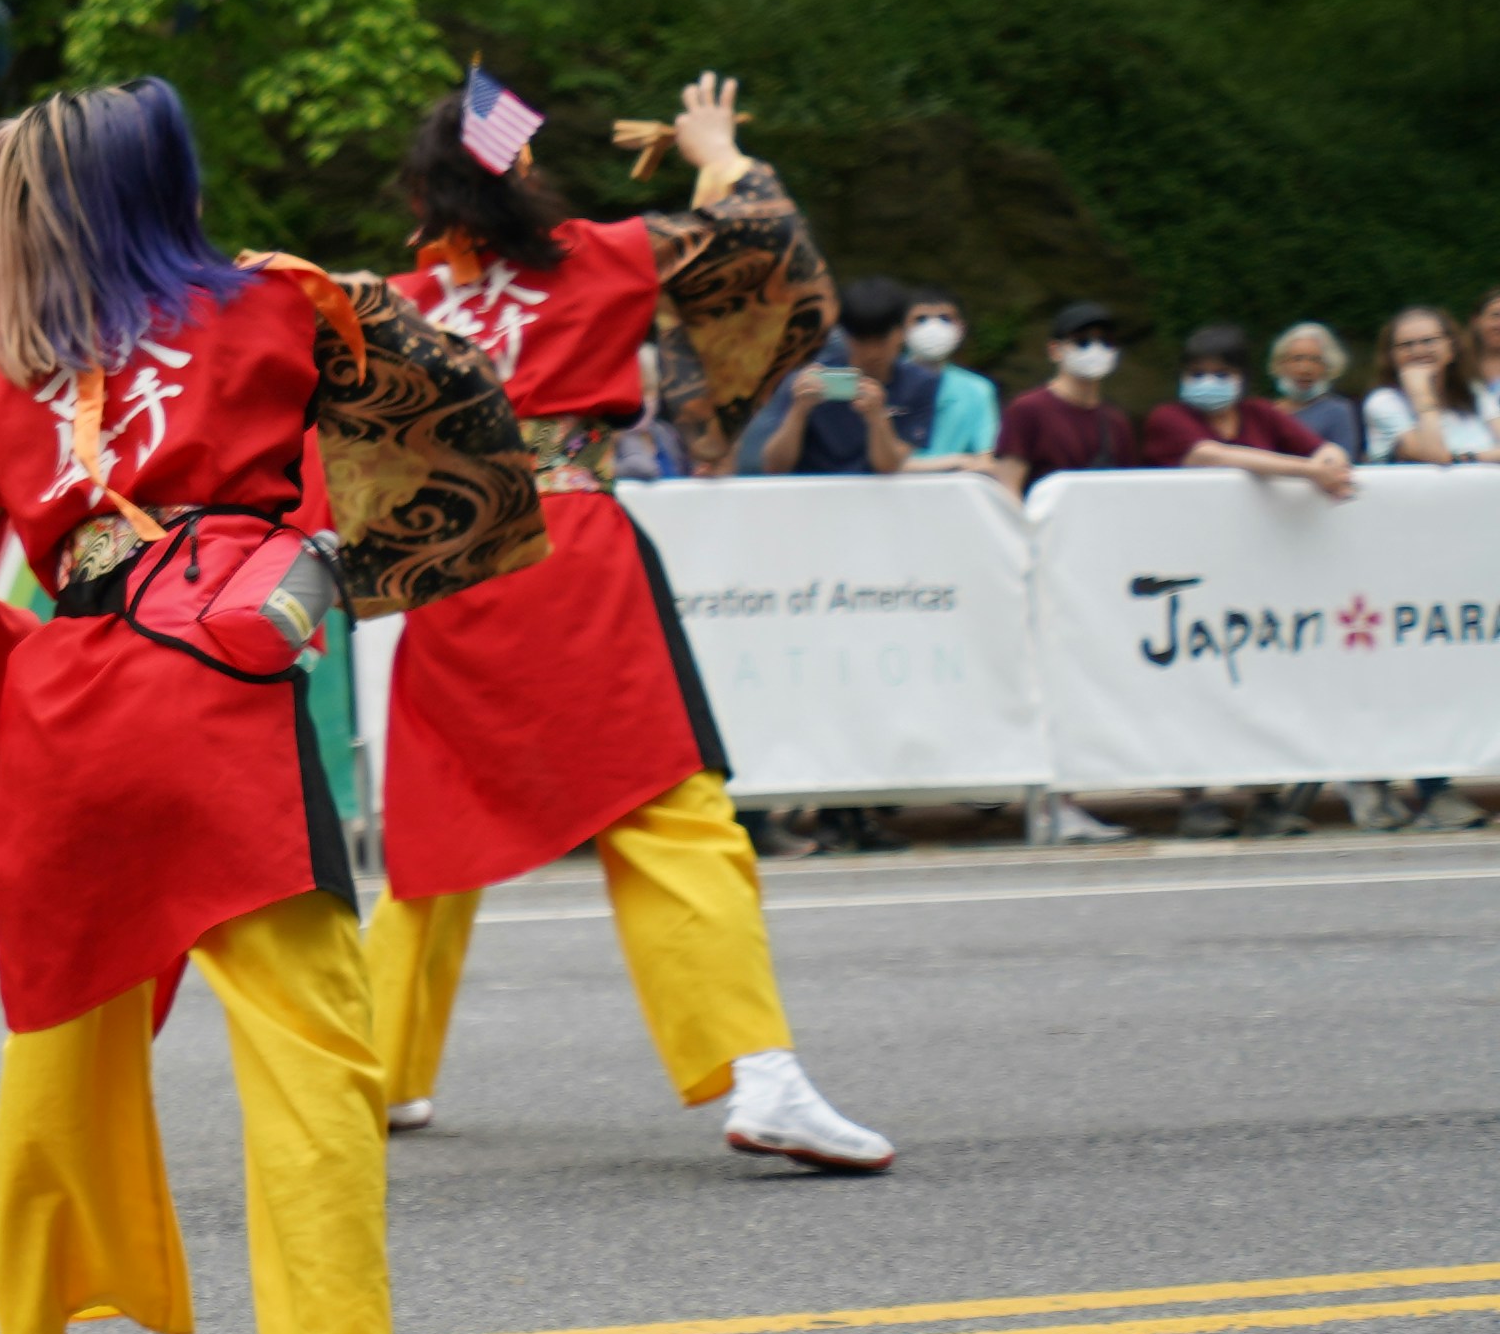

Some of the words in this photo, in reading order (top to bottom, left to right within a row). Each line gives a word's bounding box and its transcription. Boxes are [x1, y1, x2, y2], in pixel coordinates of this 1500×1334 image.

[787, 579, 819, 613] of
[828, 577, 958, 611] Americas
[1130, 575, 1325, 684] Japan
